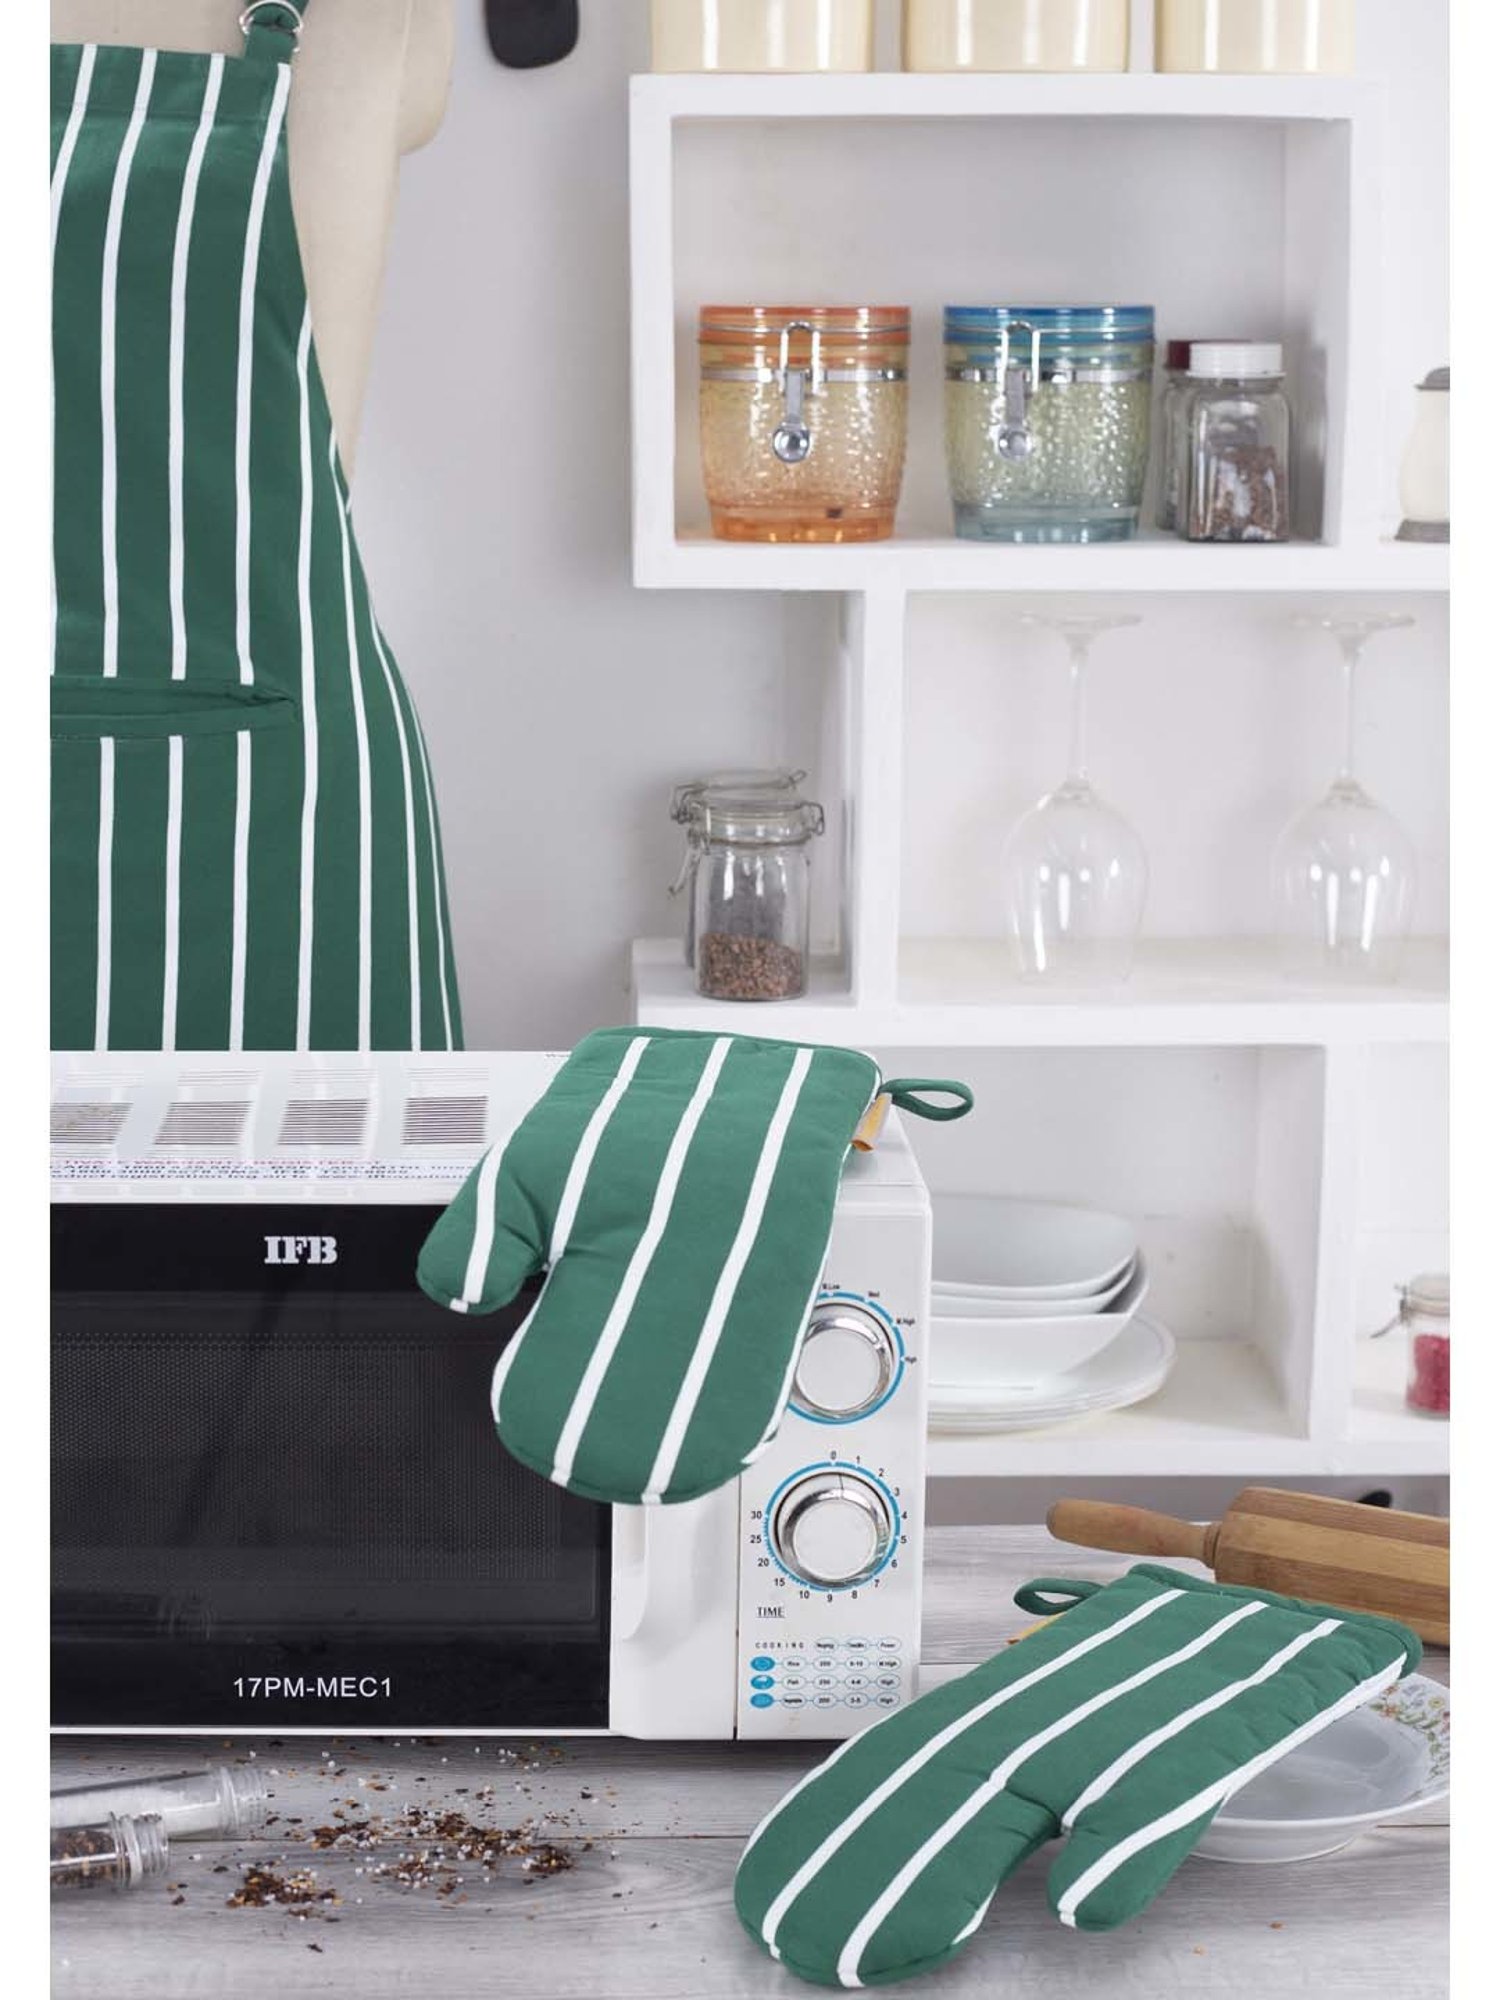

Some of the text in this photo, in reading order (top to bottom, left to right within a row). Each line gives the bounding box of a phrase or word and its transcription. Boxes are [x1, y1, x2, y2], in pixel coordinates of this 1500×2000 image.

[264, 1236, 338, 1264] IFB
[830, 1451, 837, 1460] 0
[855, 1456, 860, 1464] 1
[878, 1468, 885, 1477] 2
[894, 1487, 900, 1496] 3
[751, 1510, 762, 1520] 30
[901, 1511, 907, 1519] 4
[750, 1534, 762, 1544] 25
[900, 1535, 907, 1544] 5
[757, 1558, 769, 1567] 20
[891, 1559, 897, 1568] 6
[774, 1578, 786, 1587] 15
[874, 1579, 880, 1587] 7
[800, 1590, 810, 1599] 10
[827, 1594, 833, 1603] 9
[851, 1591, 858, 1599] 8
[757, 1606, 785, 1617] TIME
[233, 1677, 391, 1698] 17PM-MEC1
